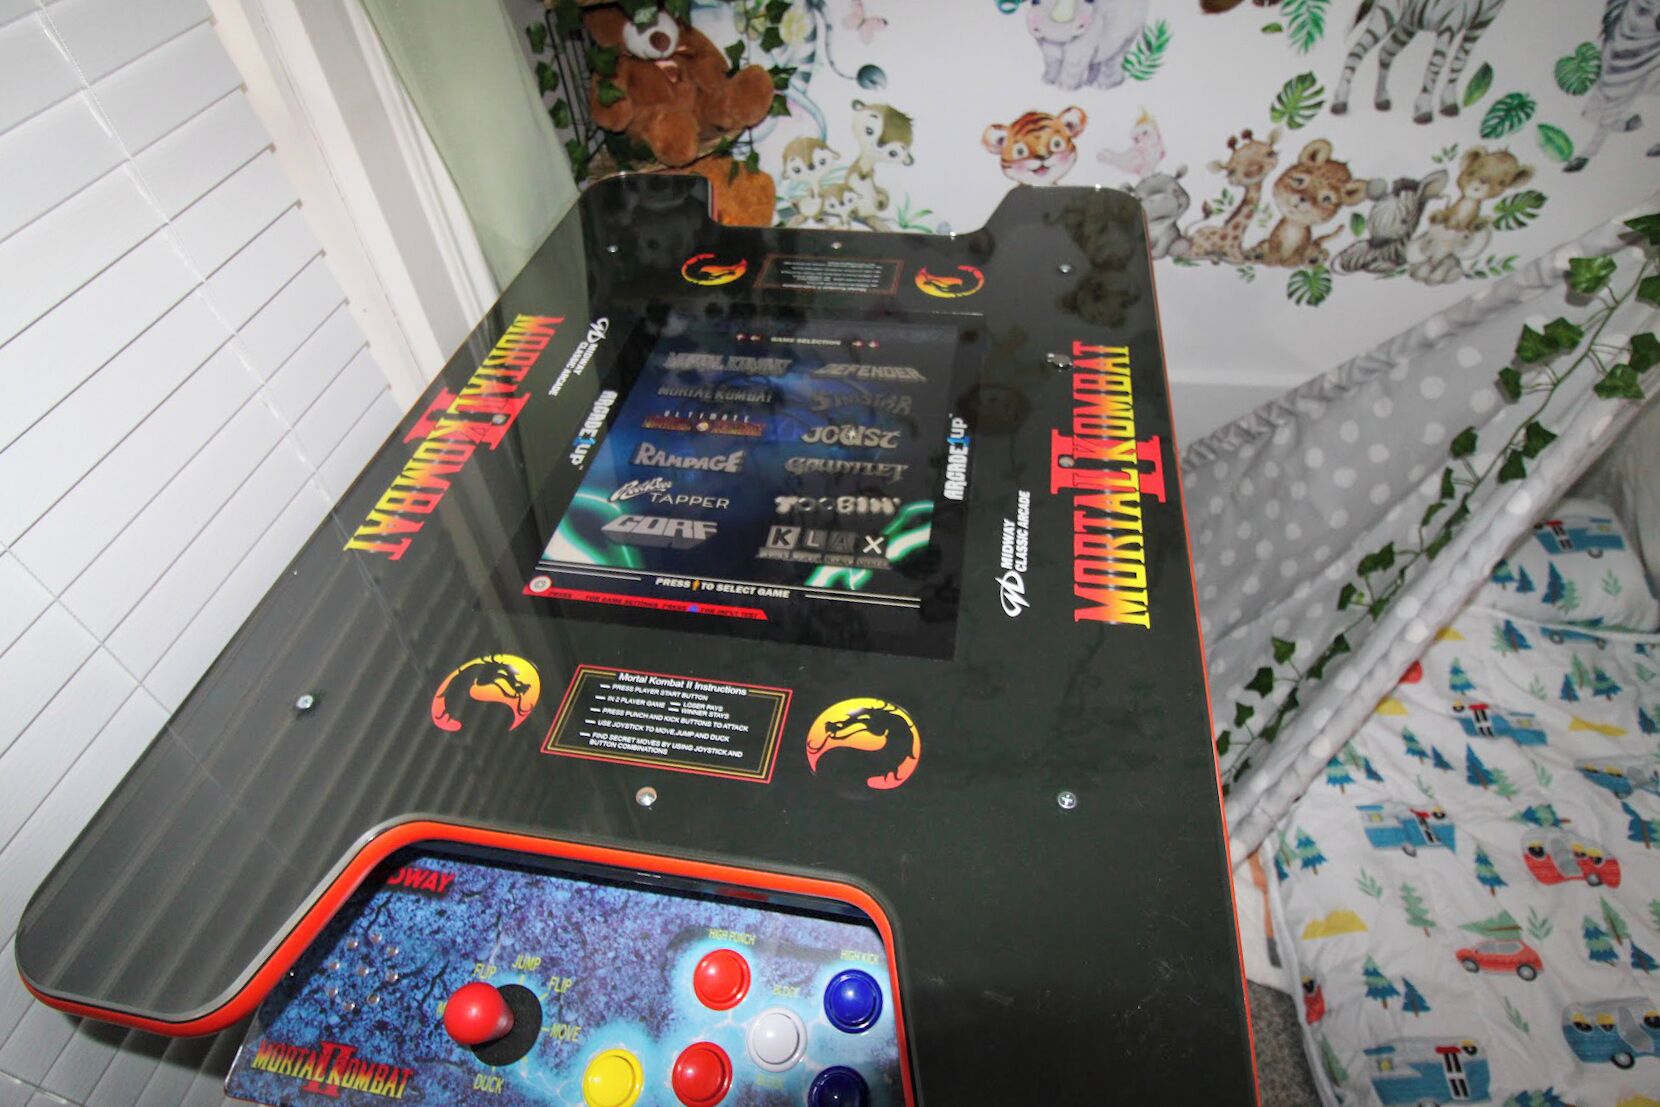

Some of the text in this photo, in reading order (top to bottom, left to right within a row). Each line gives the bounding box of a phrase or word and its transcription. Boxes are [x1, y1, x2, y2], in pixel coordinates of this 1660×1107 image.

[796, 338, 841, 346] SELECTION
[548, 341, 588, 396] CLASSIC ARCADE
[573, 343, 598, 376] MIDWAY
[810, 362, 927, 383] DEFENDER
[343, 313, 565, 560] MORTAL KOMBAT
[801, 424, 901, 449] JOUST
[633, 441, 745, 474] RAMPAGE
[784, 456, 909, 485] GAUNTLET
[1073, 340, 1150, 629] MORTAL KOMBAT
[650, 491, 731, 510] TAPPER
[601, 514, 719, 546] GORF
[1014, 490, 1031, 573] CLASSIC ARCADE
[1001, 518, 1015, 570] MIDWAY
[655, 577, 791, 598] PRESS TO SELECT GAME
[612, 683, 709, 701] PRESS PLAYER START BUTTON
[618, 672, 747, 696] Mortal Kombat II Instructions
[620, 697, 646, 706] PLAYER
[646, 700, 666, 708] GAME
[681, 708, 730, 720] WINNER STAYS
[683, 702, 723, 712] LOSER PAYS
[597, 719, 612, 727] USE
[611, 721, 644, 731] JOYSTICK
[645, 725, 654, 733] TO
[694, 732, 709, 740] AND
[709, 734, 730, 742] DUCK
[602, 707, 749, 732] PRESS PUNCH AND KICK BUTTONS TO ATTACK
[589, 738, 669, 755] BUTTON COMBINATIONS
[592, 732, 608, 740] FIND
[608, 734, 636, 743] SECRET
[636, 738, 660, 747] MOVES
[671, 743, 693, 751] USING
[693, 745, 728, 755] JOYSTICK
[728, 750, 743, 758] AND
[386, 865, 456, 893] DWAY
[472, 962, 497, 979] FLIP
[512, 954, 542, 971] JUMP
[548, 976, 573, 993] FLIP
[550, 1023, 582, 1042] MOVE
[251, 1040, 414, 1099] MORTAL KOMBAT
[472, 1073, 505, 1094] DUCK
